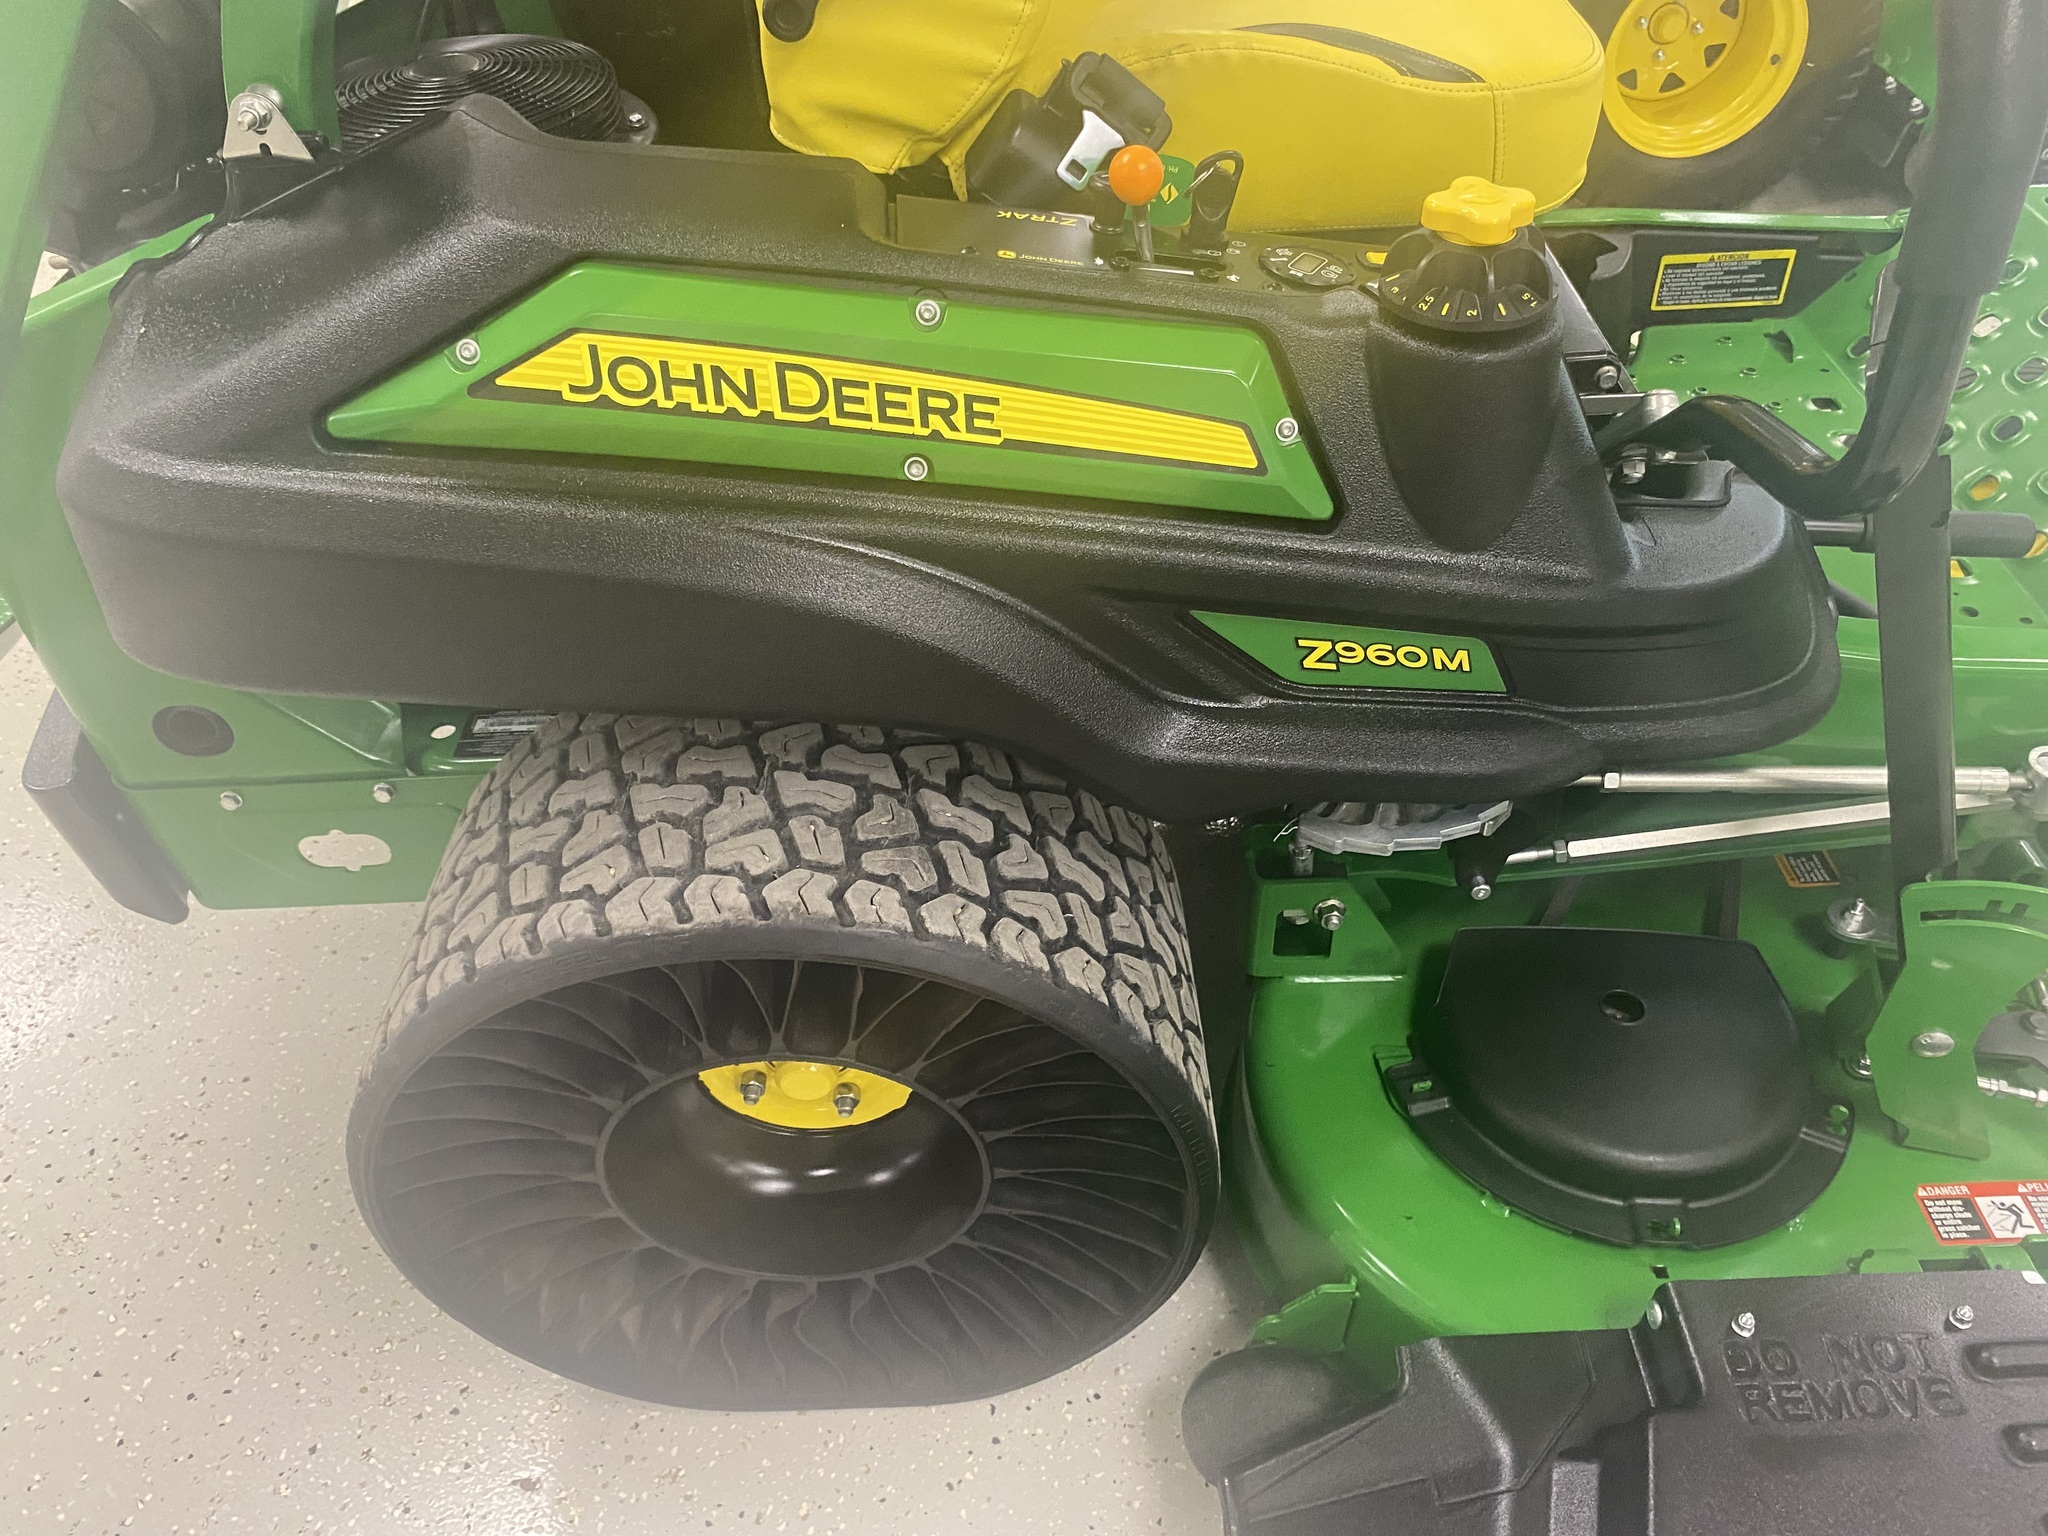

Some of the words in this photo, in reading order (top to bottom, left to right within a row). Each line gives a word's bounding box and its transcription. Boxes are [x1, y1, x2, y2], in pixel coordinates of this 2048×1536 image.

[996, 210, 1078, 227] ZTRAK
[1050, 257, 1084, 266] DEERE
[1418, 295, 1435, 311] 2.5
[1521, 292, 1538, 308] 1.5
[1466, 308, 1478, 317] 2
[567, 343, 759, 410] JOHN
[775, 360, 1003, 439] DEERE
[1296, 637, 1472, 673] Z960M
[1926, 1185, 1971, 1196] DANGER
[1721, 1338, 1798, 1378] DO
[1820, 1332, 1934, 1378] NOT
[1735, 1377, 1968, 1422] REMOVE
